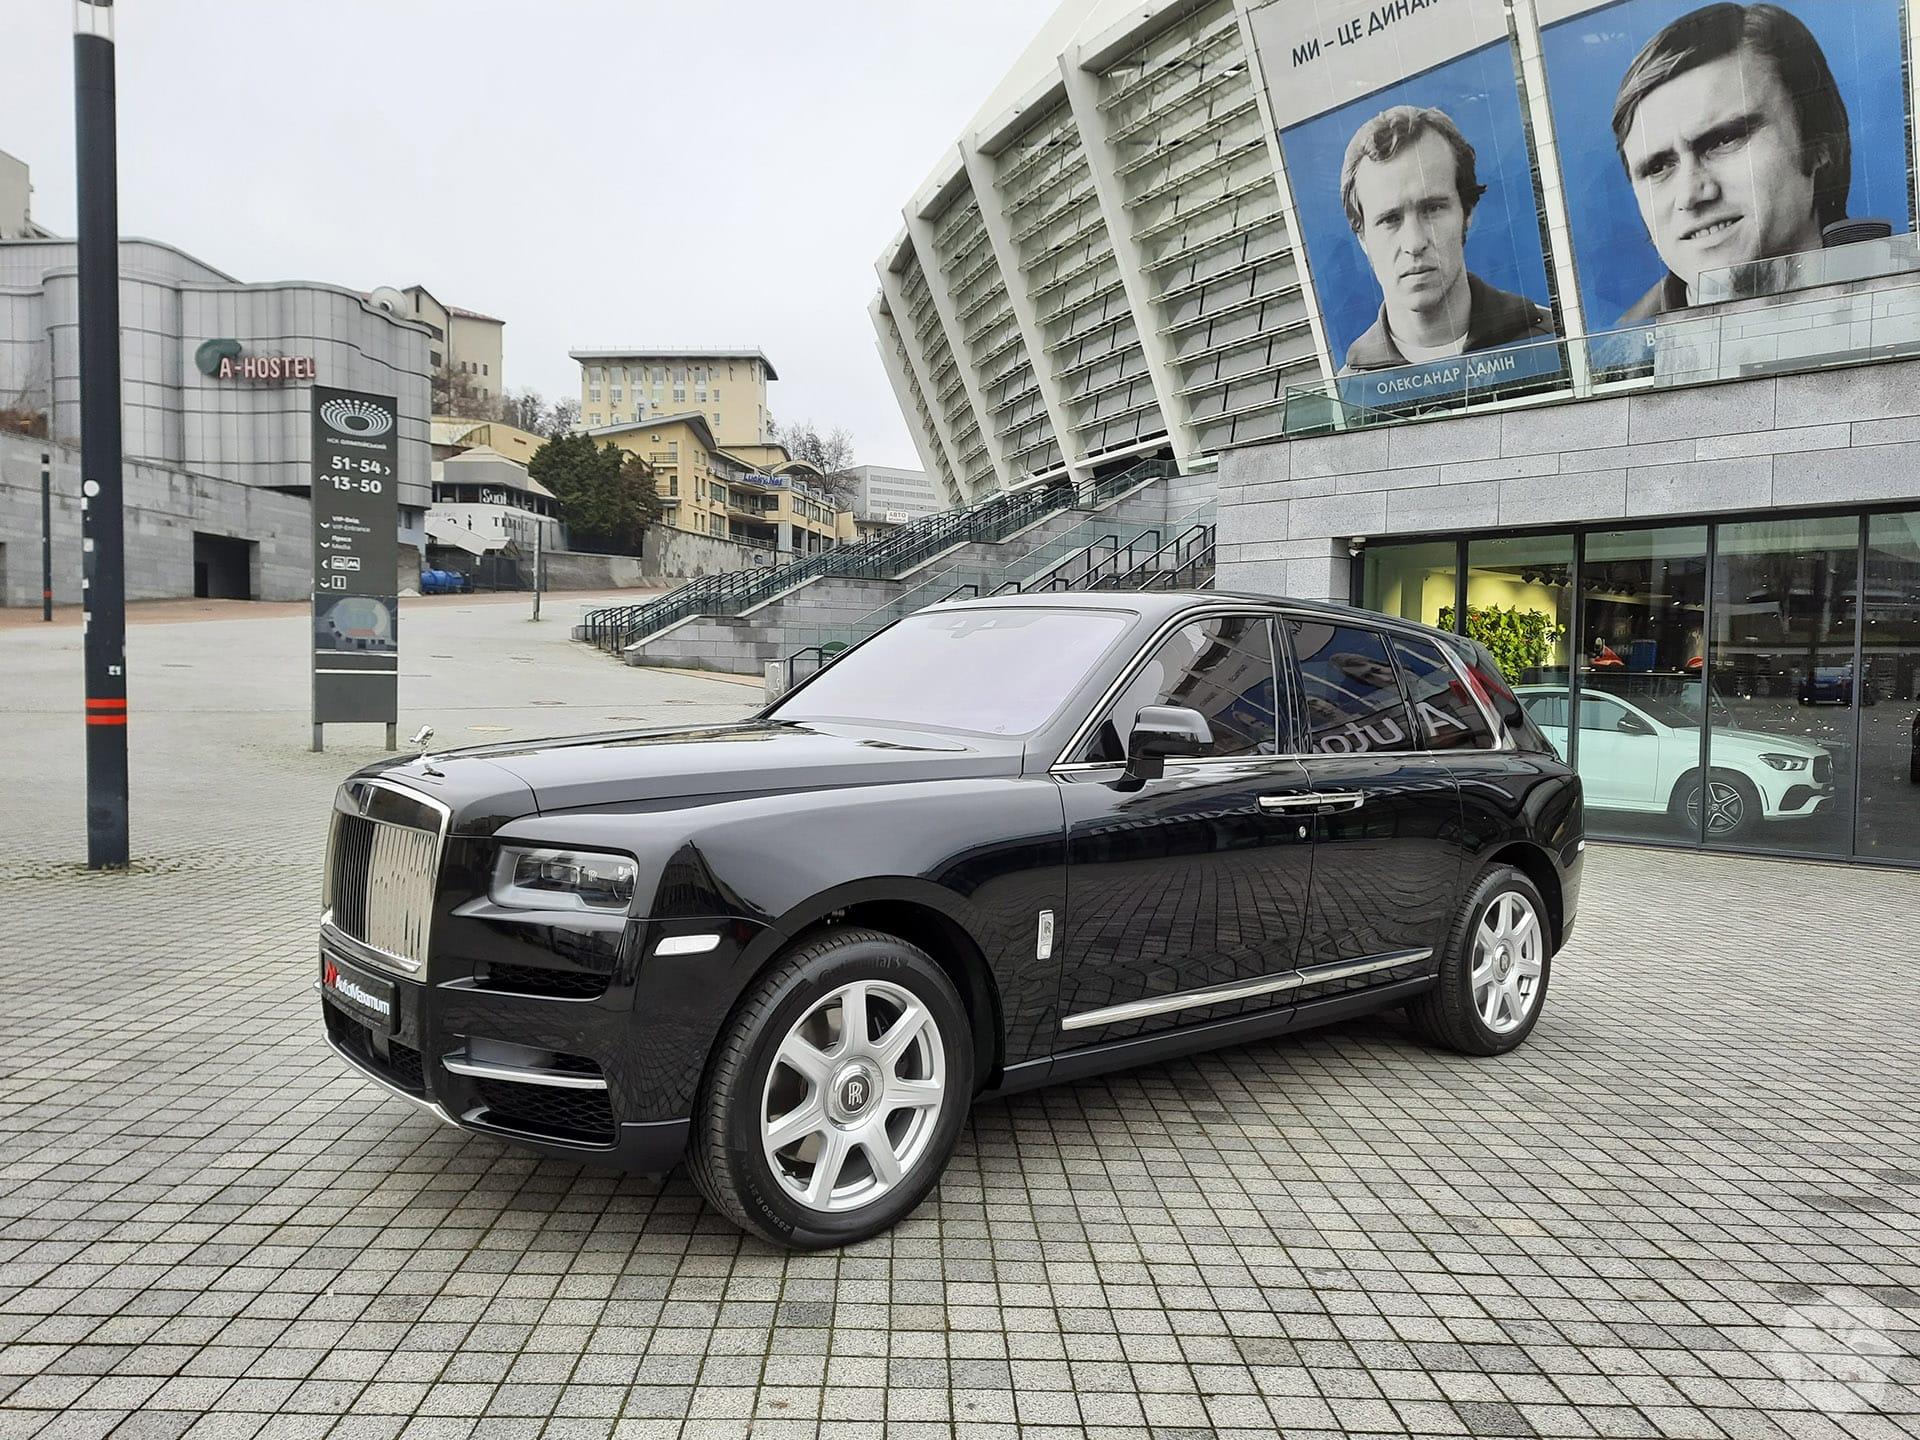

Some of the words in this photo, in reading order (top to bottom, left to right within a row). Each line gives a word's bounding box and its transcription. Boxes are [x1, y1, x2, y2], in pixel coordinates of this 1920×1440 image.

[1292, 38, 1320, 67] МИ
[1337, 18, 1363, 46] ЦЕ
[1368, 0, 1438, 36] ДИНА
[1645, 331, 1656, 347] В
[219, 357, 316, 379] A-HOSTEL
[1376, 367, 1460, 395] ОЛЕКСАНДР
[1465, 355, 1516, 380] ДАМІН
[331, 455, 381, 474] 51-54
[331, 475, 382, 494] 13-50
